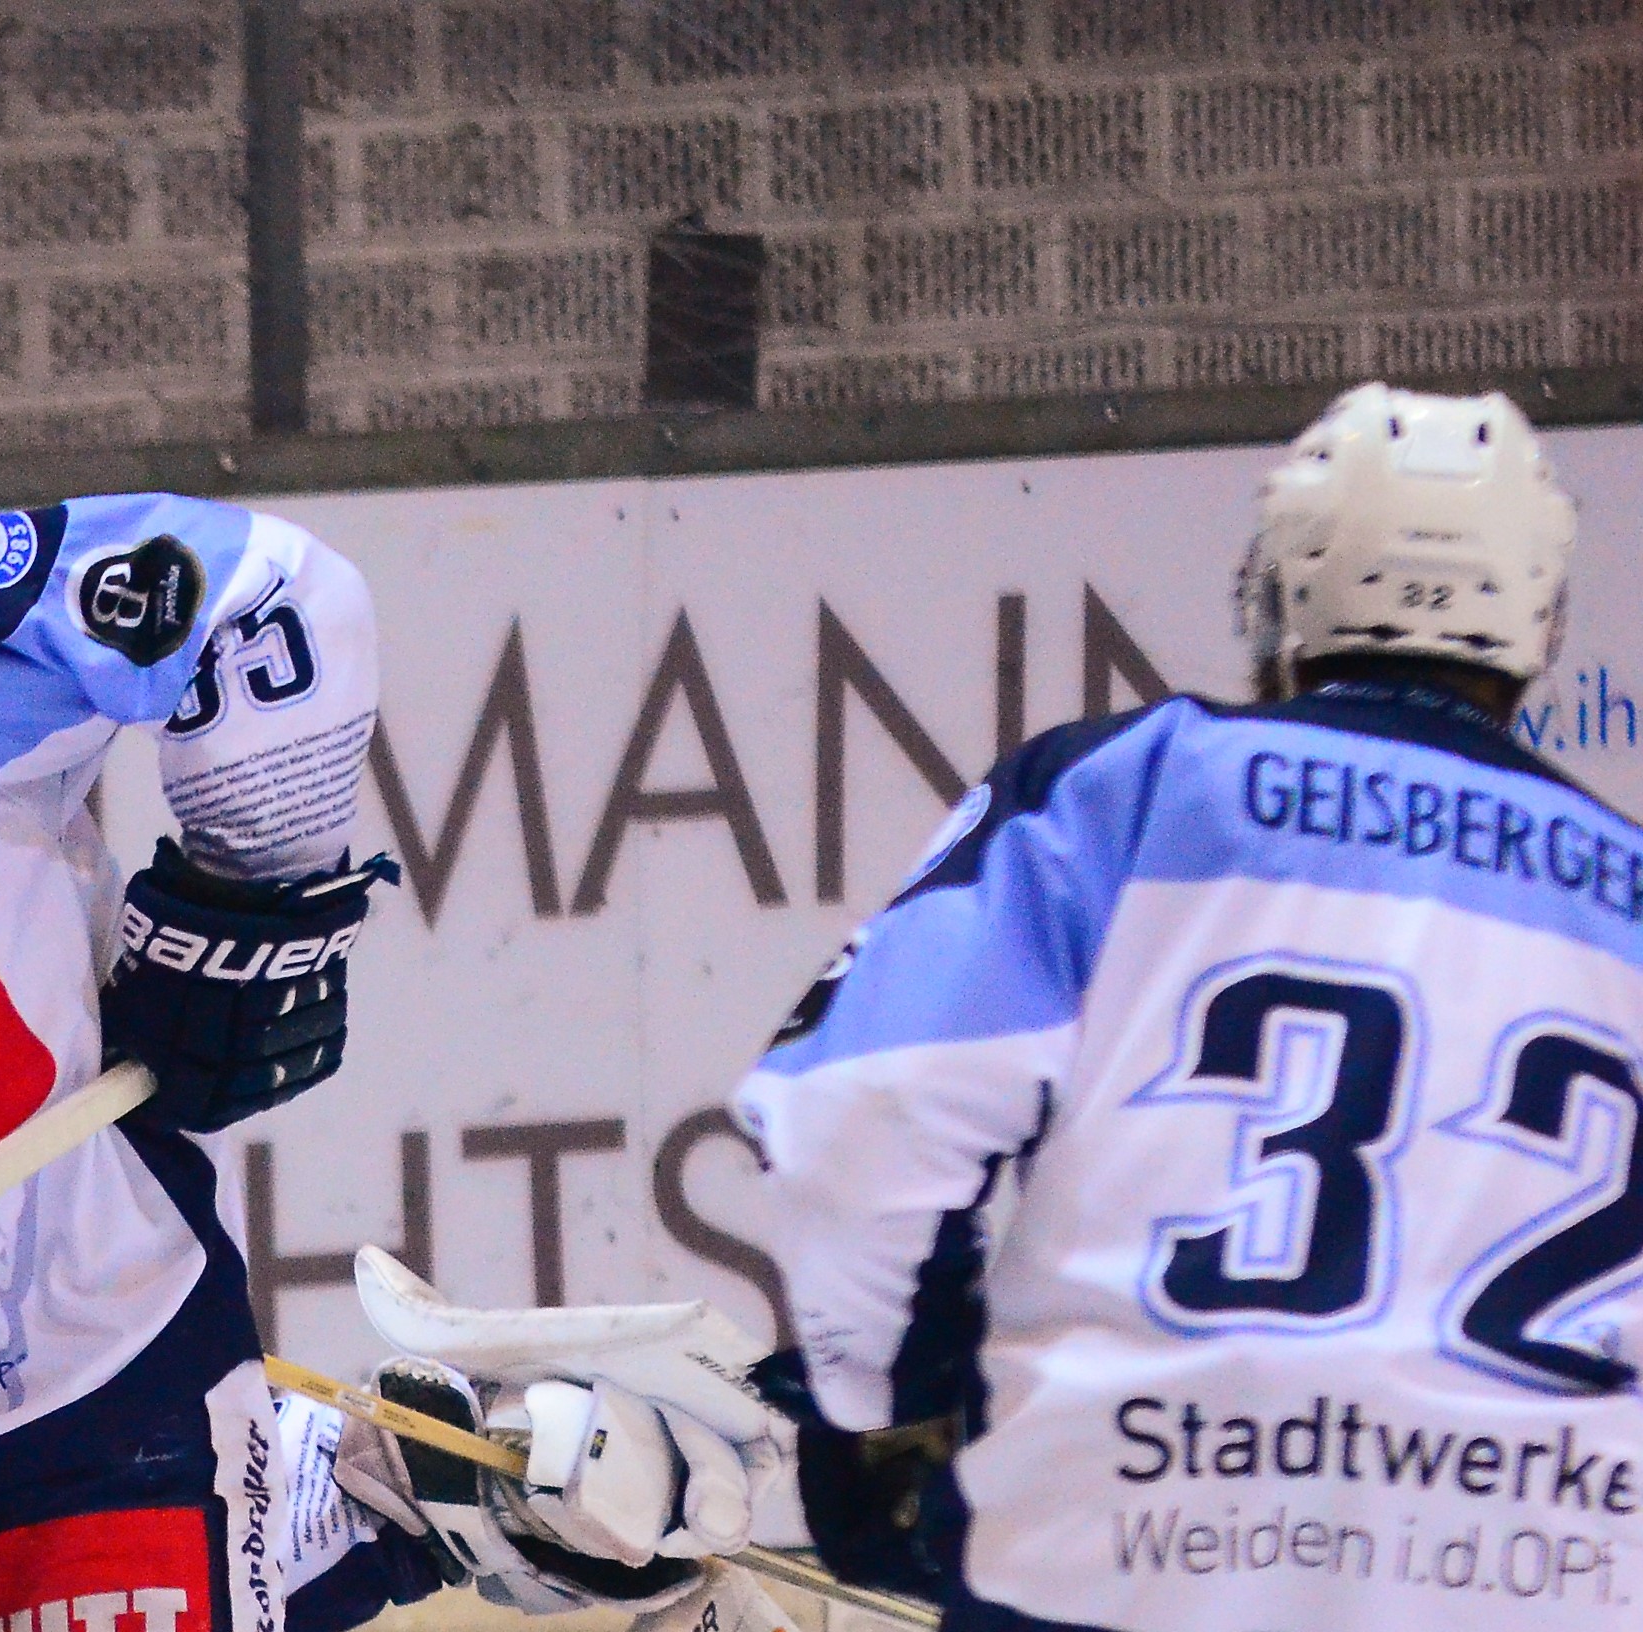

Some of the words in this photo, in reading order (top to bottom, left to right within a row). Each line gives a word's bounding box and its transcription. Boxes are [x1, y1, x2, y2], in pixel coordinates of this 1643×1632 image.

[1123, 949, 1643, 1398] 32
[1117, 1396, 1641, 1514] Stadtwerke
[1116, 1507, 1373, 1580] Weiden
